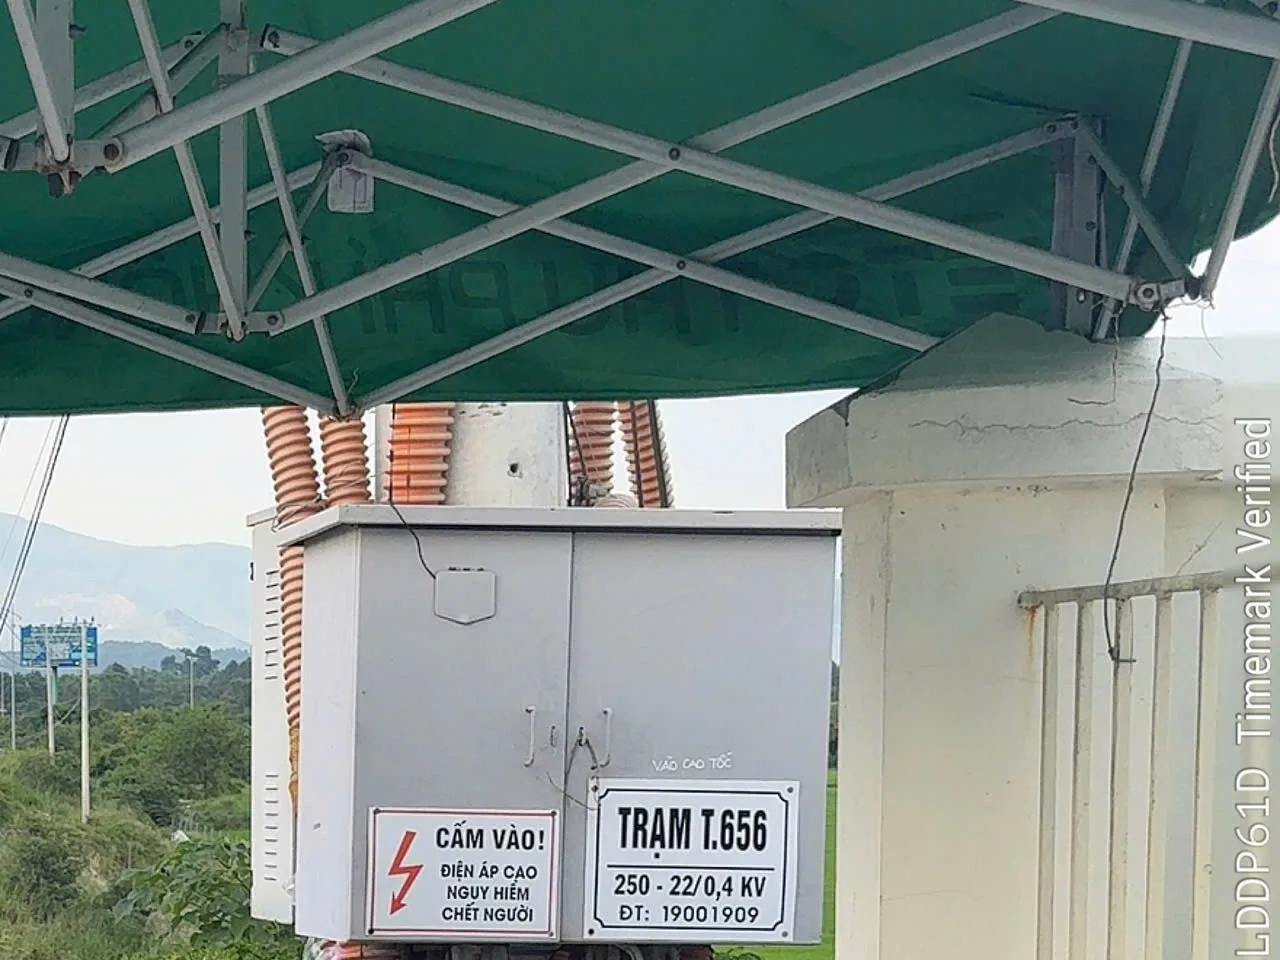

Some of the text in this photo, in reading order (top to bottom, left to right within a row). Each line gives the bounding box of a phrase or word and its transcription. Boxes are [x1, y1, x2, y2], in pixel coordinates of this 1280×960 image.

[682, 758, 705, 769] CAO
[436, 820, 545, 850] CẤM VÀO!
[618, 807, 767, 859] TRẠM T.656
[441, 860, 537, 881] ĐIỆN ÁP CAO
[447, 879, 529, 900] NGUY HIỂM
[614, 874, 650, 895] 250
[669, 875, 733, 901] 22/0,4
[741, 876, 766, 897] KV
[442, 902, 533, 922] CHẾT NGƯỜI
[620, 905, 759, 923] ĐT: 19001909
